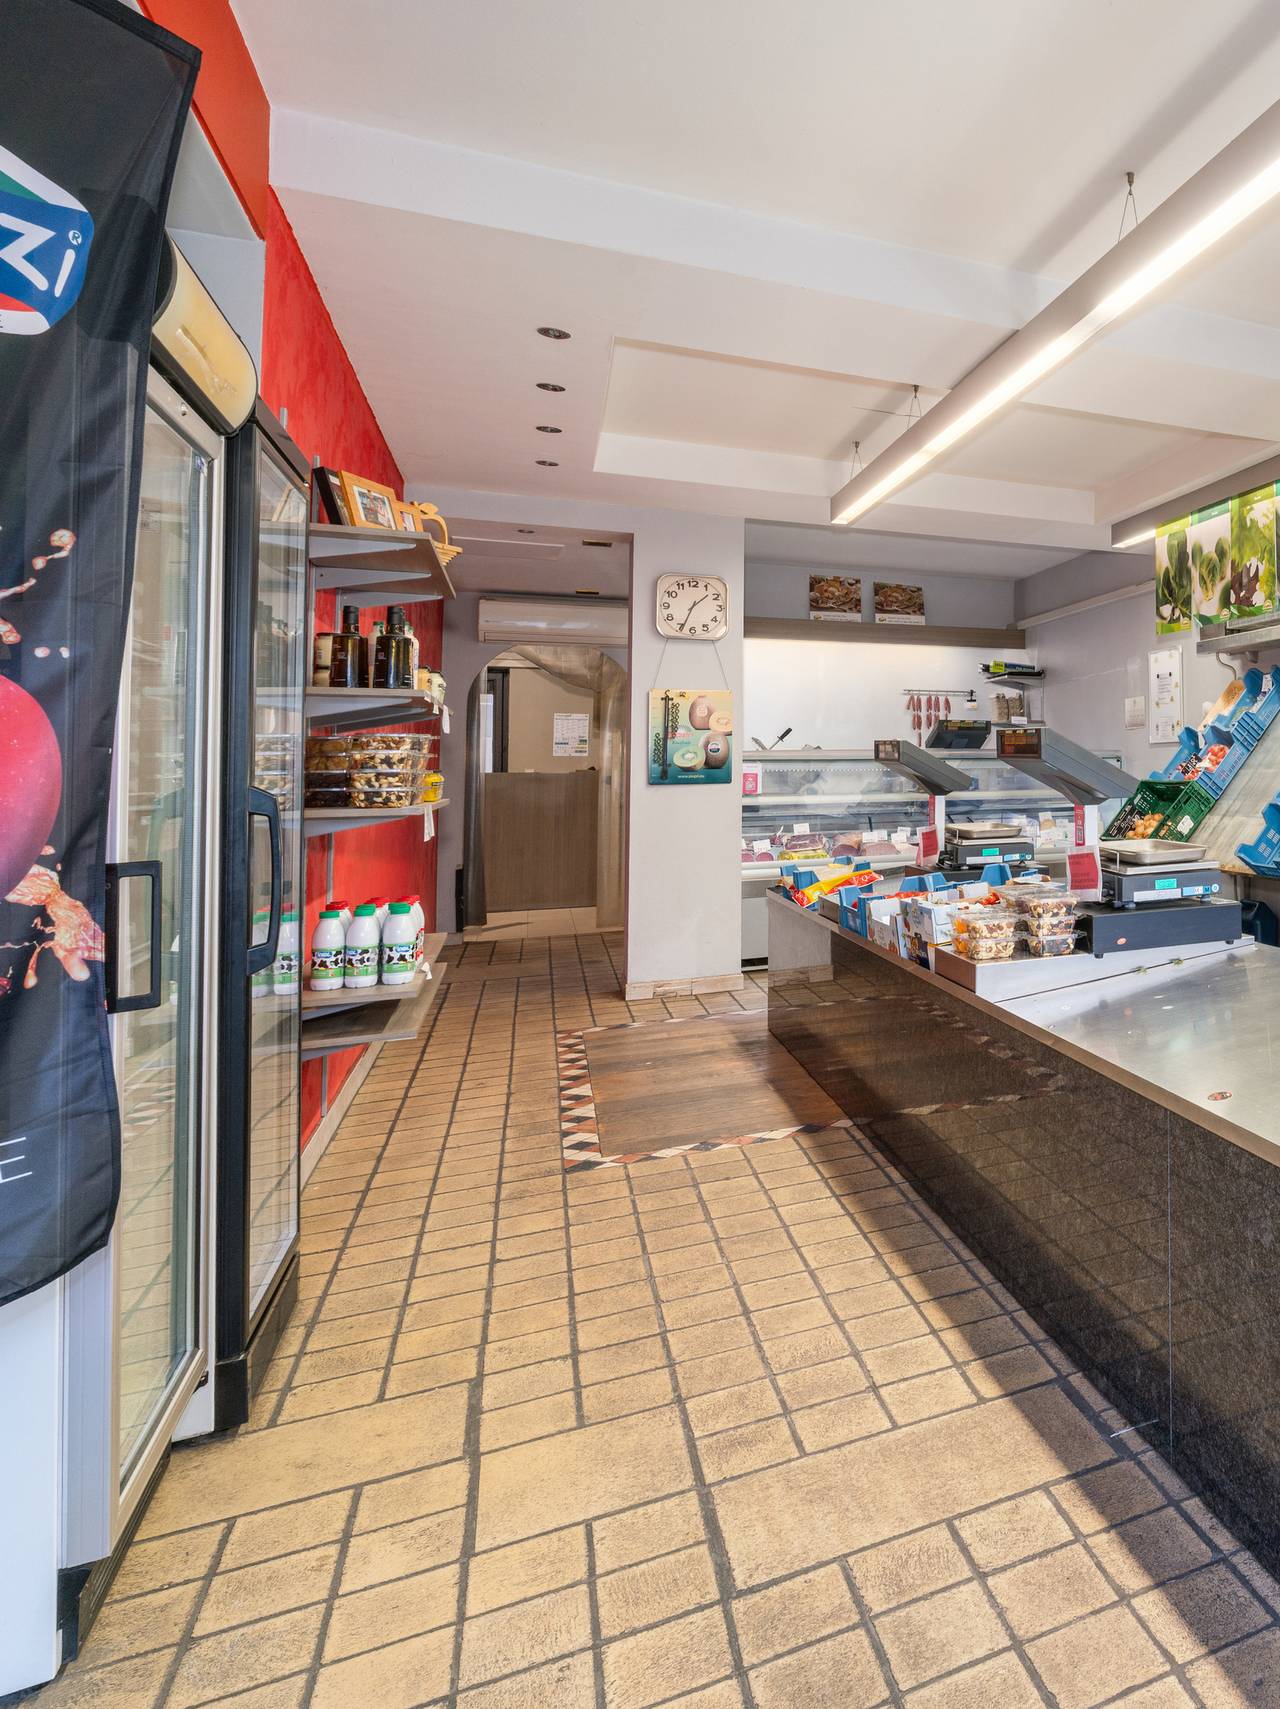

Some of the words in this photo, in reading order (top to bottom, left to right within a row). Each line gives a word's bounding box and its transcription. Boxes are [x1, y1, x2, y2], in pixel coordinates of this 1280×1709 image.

[676, 582, 685, 590] 11
[687, 580, 699, 588] 12
[704, 583, 708, 591] 1
[666, 590, 678, 598] 10
[712, 593, 720, 601] 2
[662, 602, 670, 610] 9
[716, 604, 723, 612] 3
[665, 613, 674, 622] 8
[676, 622, 684, 632] 7
[688, 626, 697, 635] 6
[702, 623, 709, 632] 5
